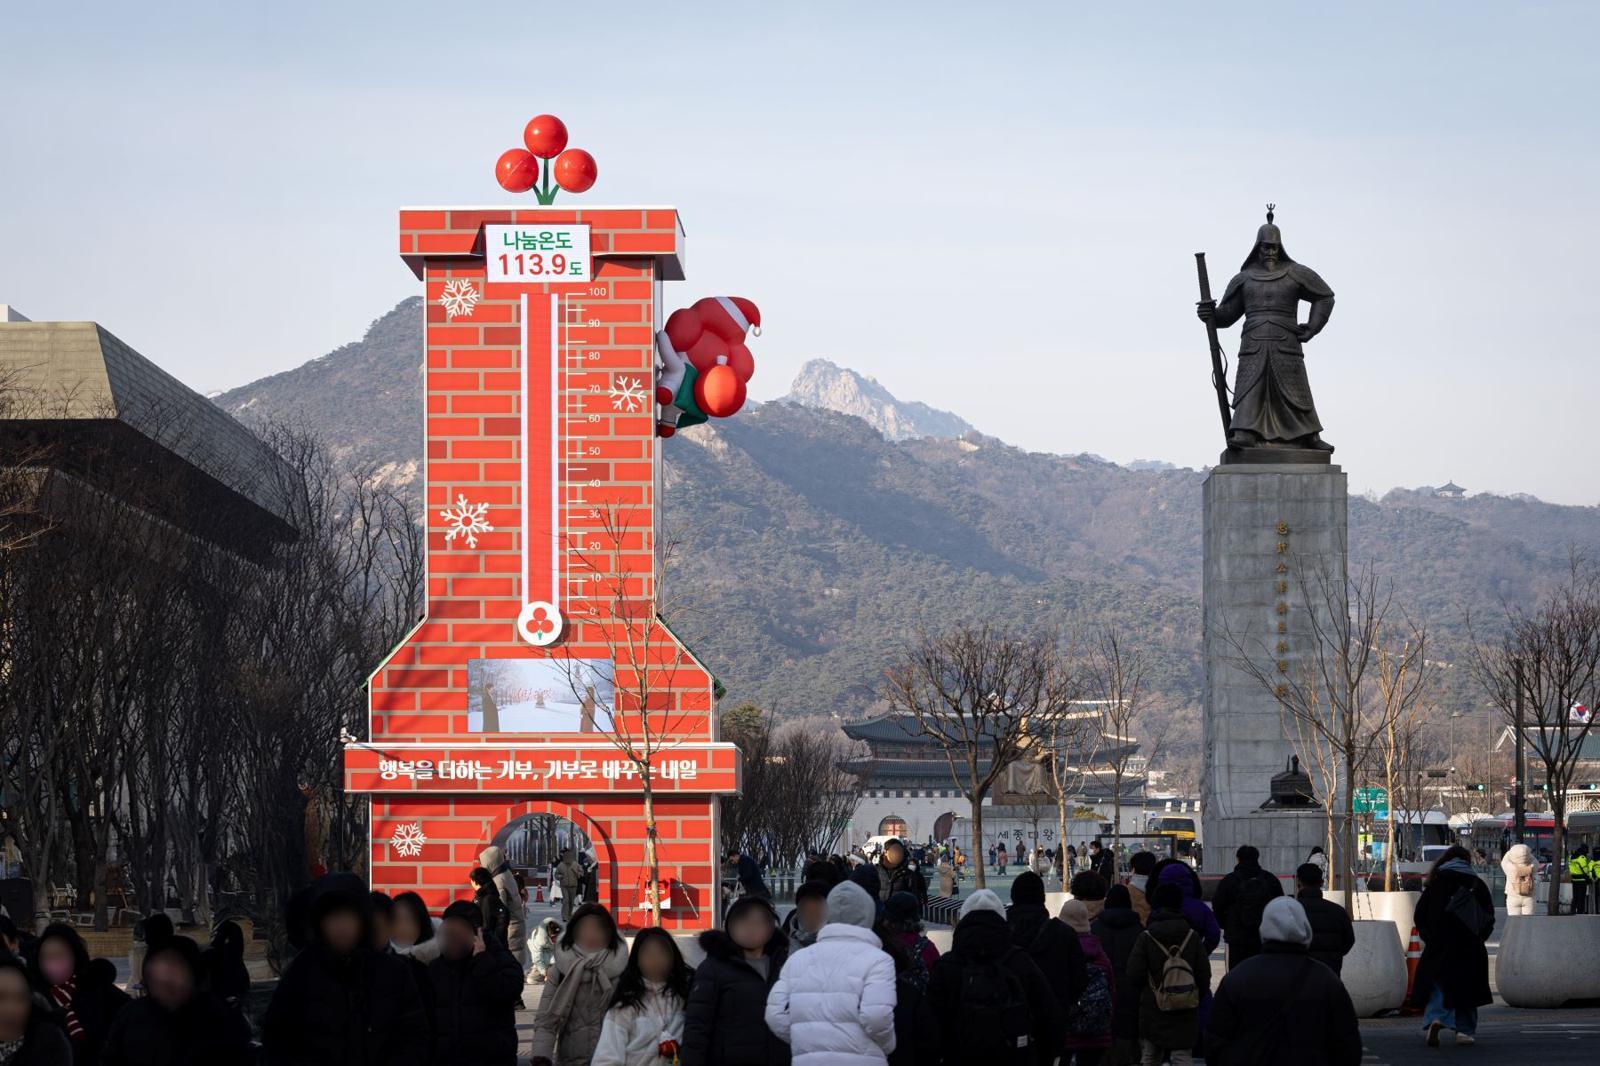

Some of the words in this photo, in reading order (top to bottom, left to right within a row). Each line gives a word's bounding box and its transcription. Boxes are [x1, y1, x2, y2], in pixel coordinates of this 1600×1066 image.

[503, 230, 573, 251] 나눔온도
[589, 287, 607, 296] 100
[588, 319, 600, 328] 90
[588, 351, 600, 360] 80
[589, 384, 600, 393] 70
[588, 414, 601, 423] 60
[589, 446, 601, 455] 50
[588, 479, 601, 488] 40
[589, 509, 601, 518] 30
[589, 541, 601, 550] 20
[590, 573, 602, 582] 10
[589, 606, 596, 616] 0
[378, 759, 434, 780] 행복을
[438, 759, 493, 780] 더하는
[496, 759, 539, 781] 기부,
[543, 759, 599, 780] 기부로
[660, 759, 697, 780] 내일
[997, 828, 1055, 841] 세종대왕
